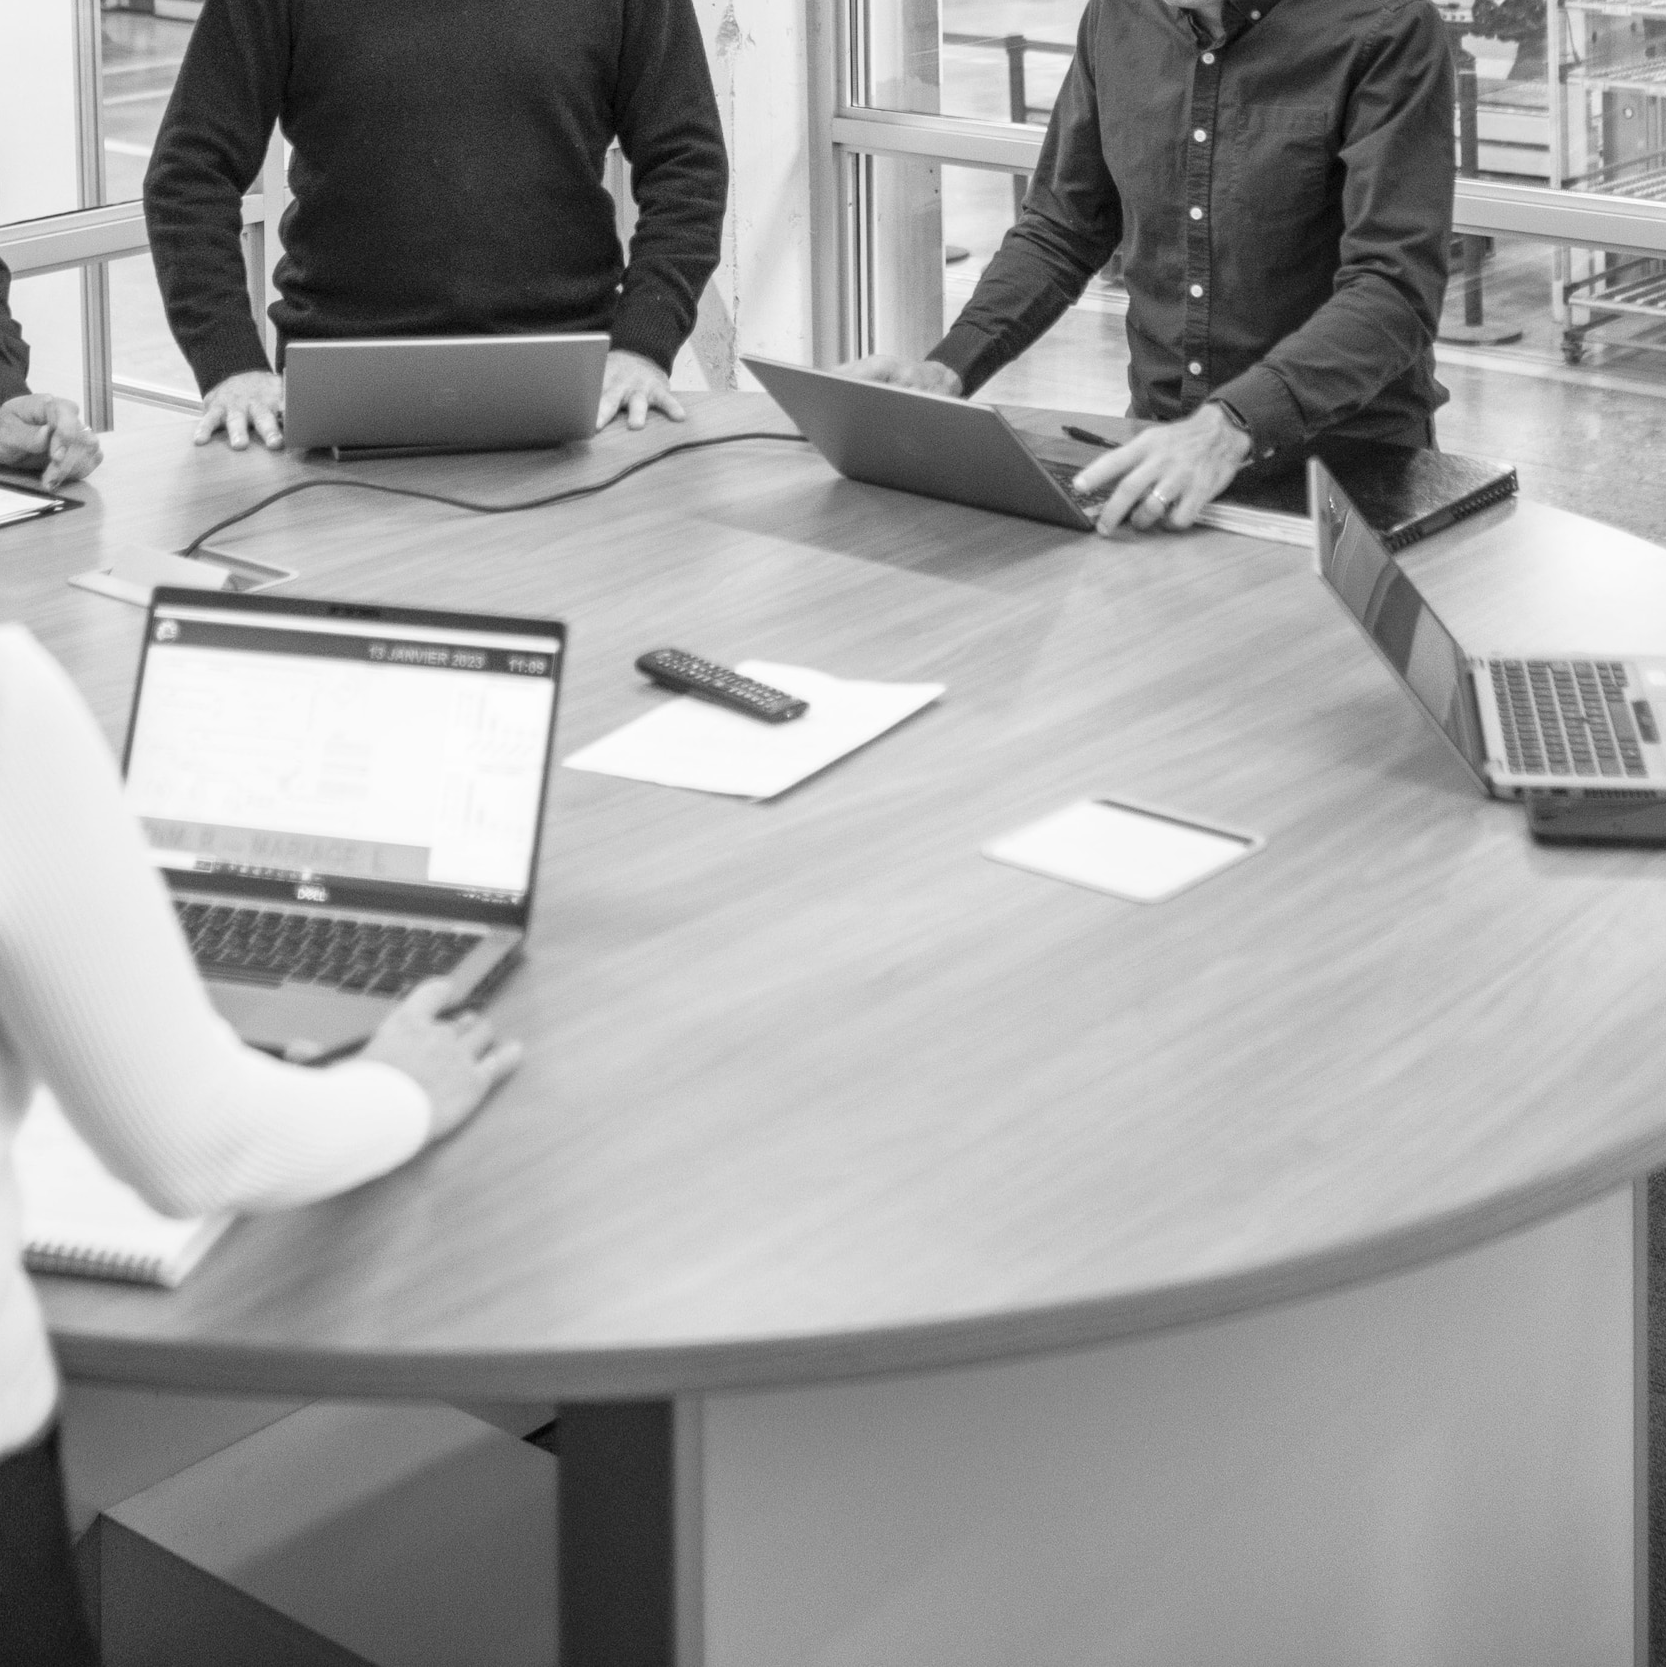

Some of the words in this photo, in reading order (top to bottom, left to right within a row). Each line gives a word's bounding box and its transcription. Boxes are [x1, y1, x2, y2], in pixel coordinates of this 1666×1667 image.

[387, 647, 448, 666] JANVIER
[451, 653, 484, 670] 2023
[508, 658, 546, 675] 11:09
[296, 886, 328, 902] DELL
